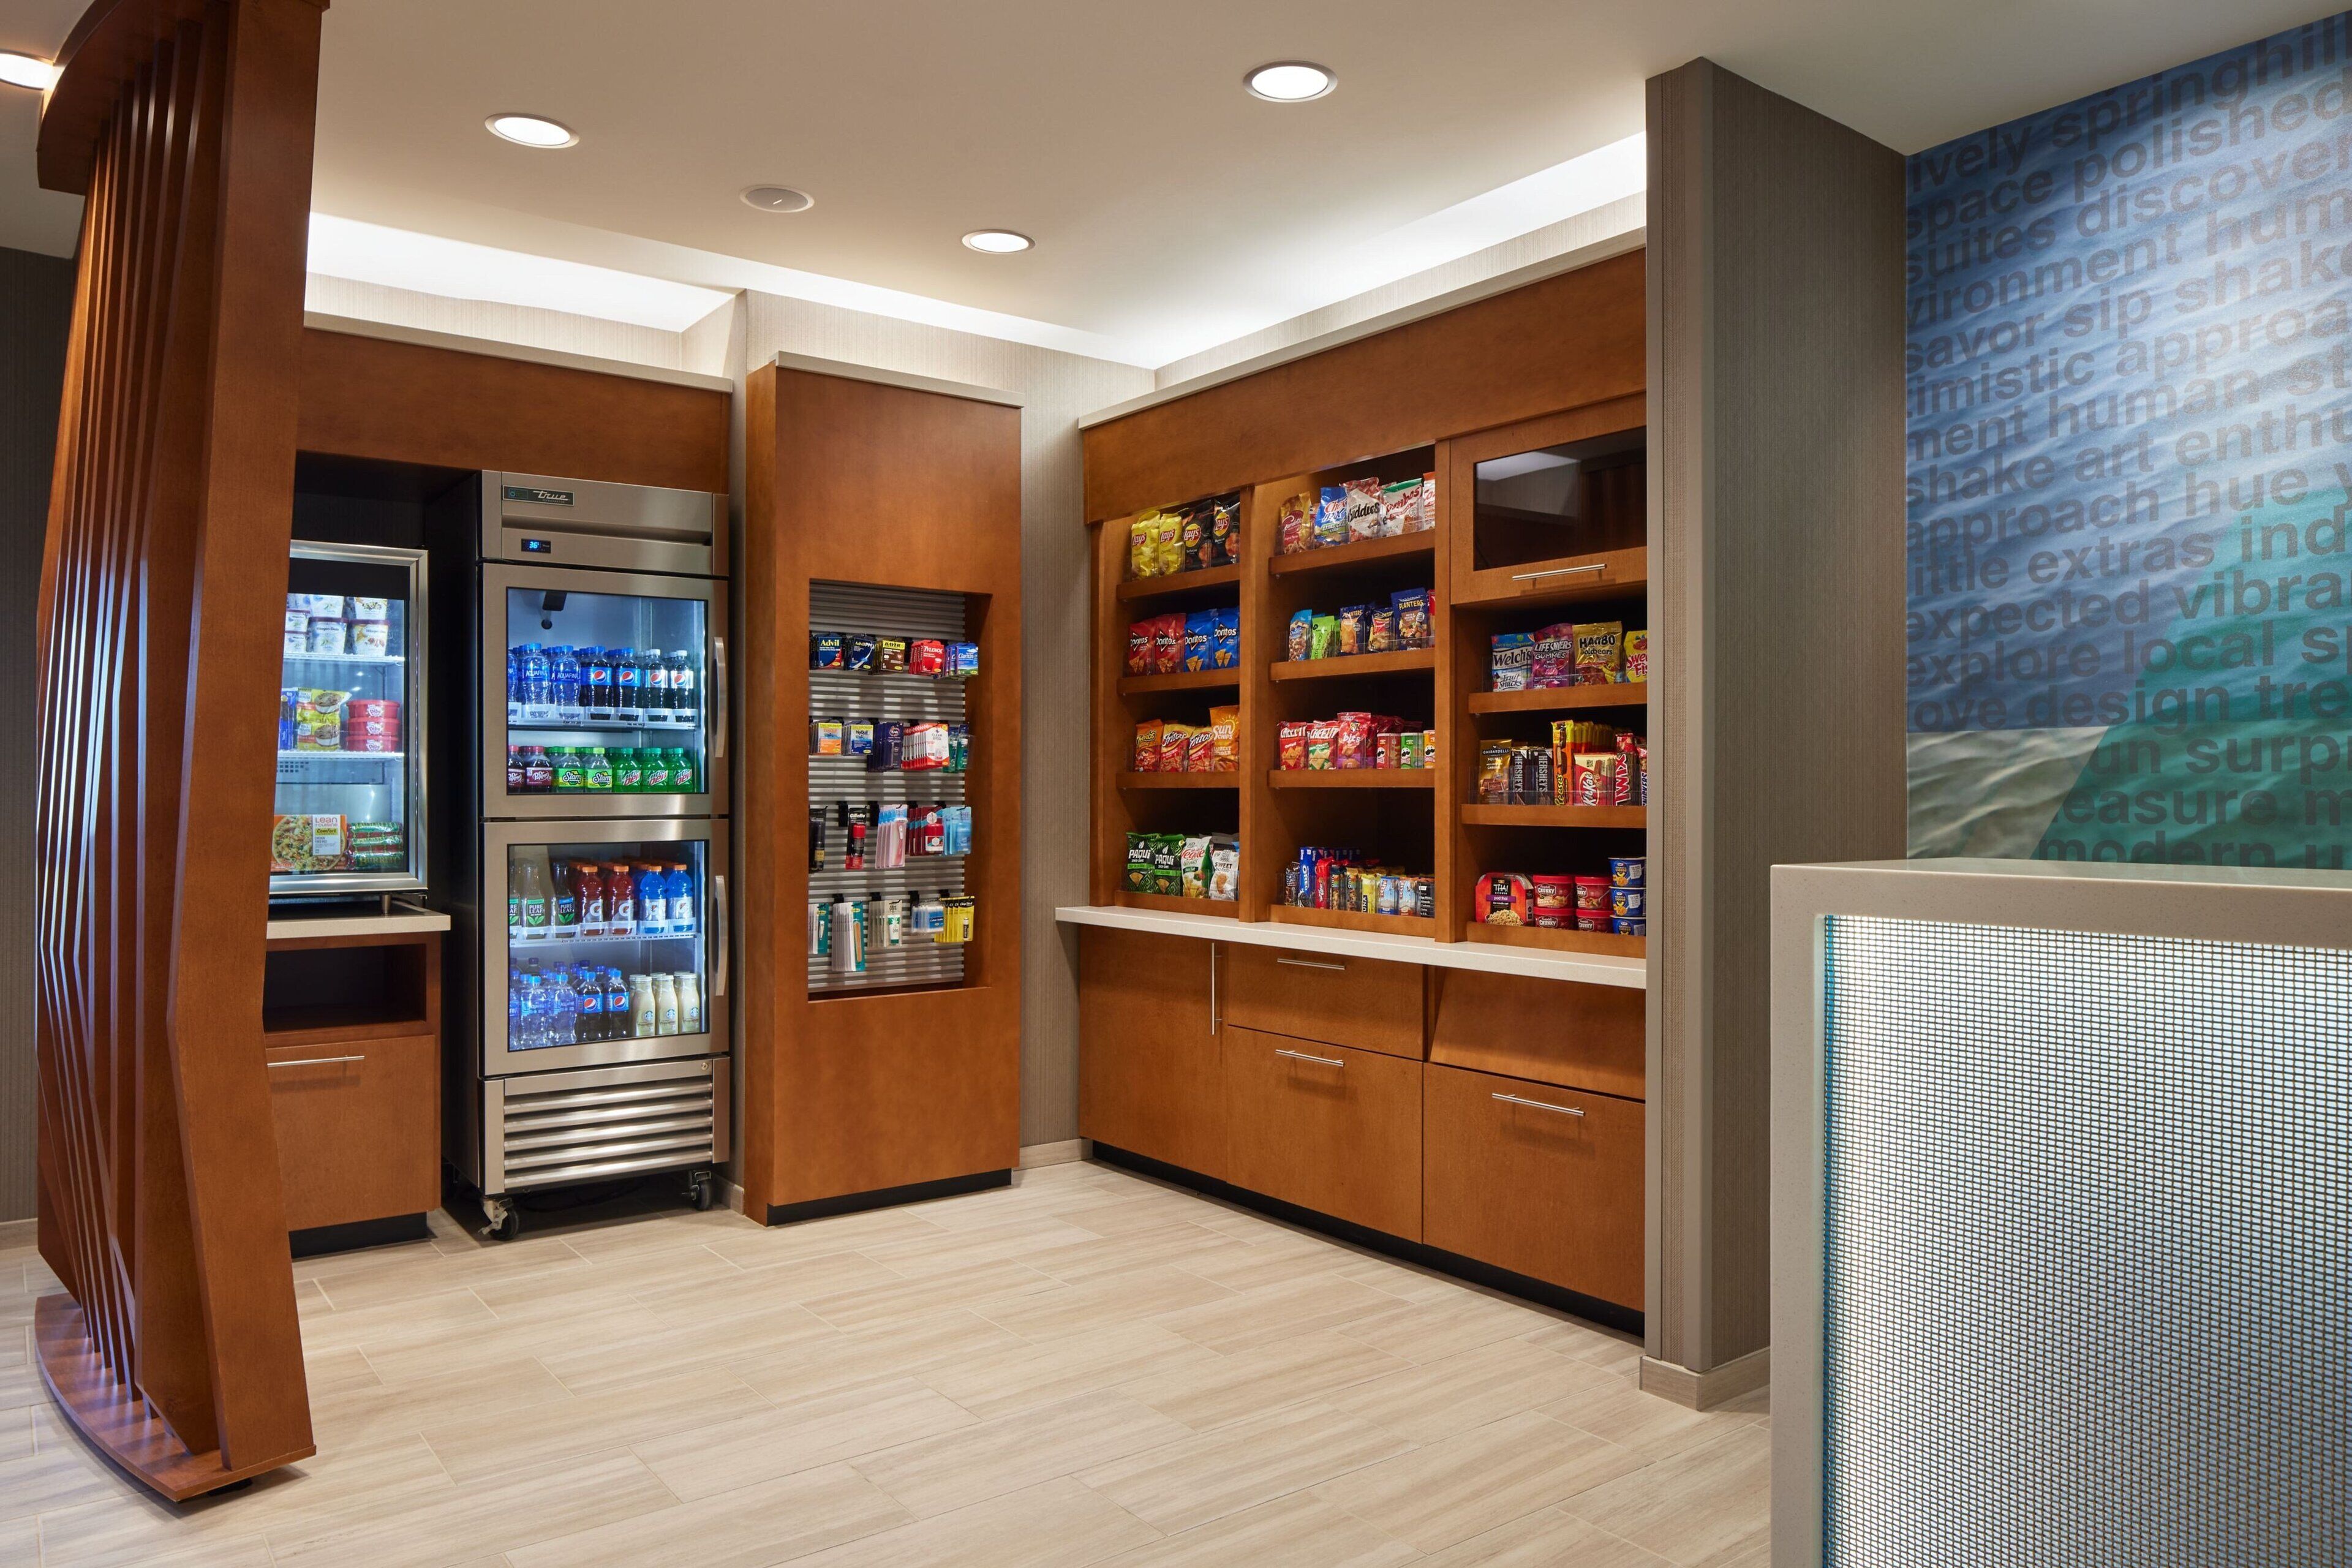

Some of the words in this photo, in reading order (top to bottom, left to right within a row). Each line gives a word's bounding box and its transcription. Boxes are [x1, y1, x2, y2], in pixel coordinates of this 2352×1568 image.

[1907, 170, 2053, 244] space
[2074, 67, 2352, 203] polished
[1907, 216, 2057, 285] suites
[1907, 312, 2045, 374] savor
[2064, 287, 2152, 339] sip
[2049, 363, 2260, 437] human
[1907, 453, 2056, 508] shake
[2075, 436, 2154, 483] art
[1907, 480, 2159, 561] approach
[2185, 468, 2309, 517] hue
[1133, 532, 1147, 546] Lay's
[1160, 528, 1175, 543] Lay's
[1183, 528, 1200, 541] Lay's
[2028, 530, 2215, 584] extras
[2241, 502, 2346, 564] ind
[1399, 600, 1425, 611] PLANTERS
[1907, 579, 2150, 647] expected
[2172, 569, 2352, 620] vibra
[1185, 635, 1207, 645] Doritos
[1214, 628, 1237, 637] Doritos
[1534, 642, 1550, 652] LIFE
[1550, 640, 1572, 650] SAVERS
[1493, 649, 1531, 667] Welch's
[1907, 641, 2100, 704] explore
[2124, 620, 2274, 676] local
[1499, 680, 1522, 689] Snacks
[2026, 679, 2230, 736] design
[2255, 674, 2350, 723] tre
[1162, 730, 1188, 747] Fritos
[1189, 731, 1212, 749] Fritos
[1213, 725, 1232, 740] Sun
[1343, 732, 1362, 743] bits
[1615, 754, 1632, 806] TWIX
[2052, 789, 2278, 824] easure
[1493, 884, 1509, 892] THAI
